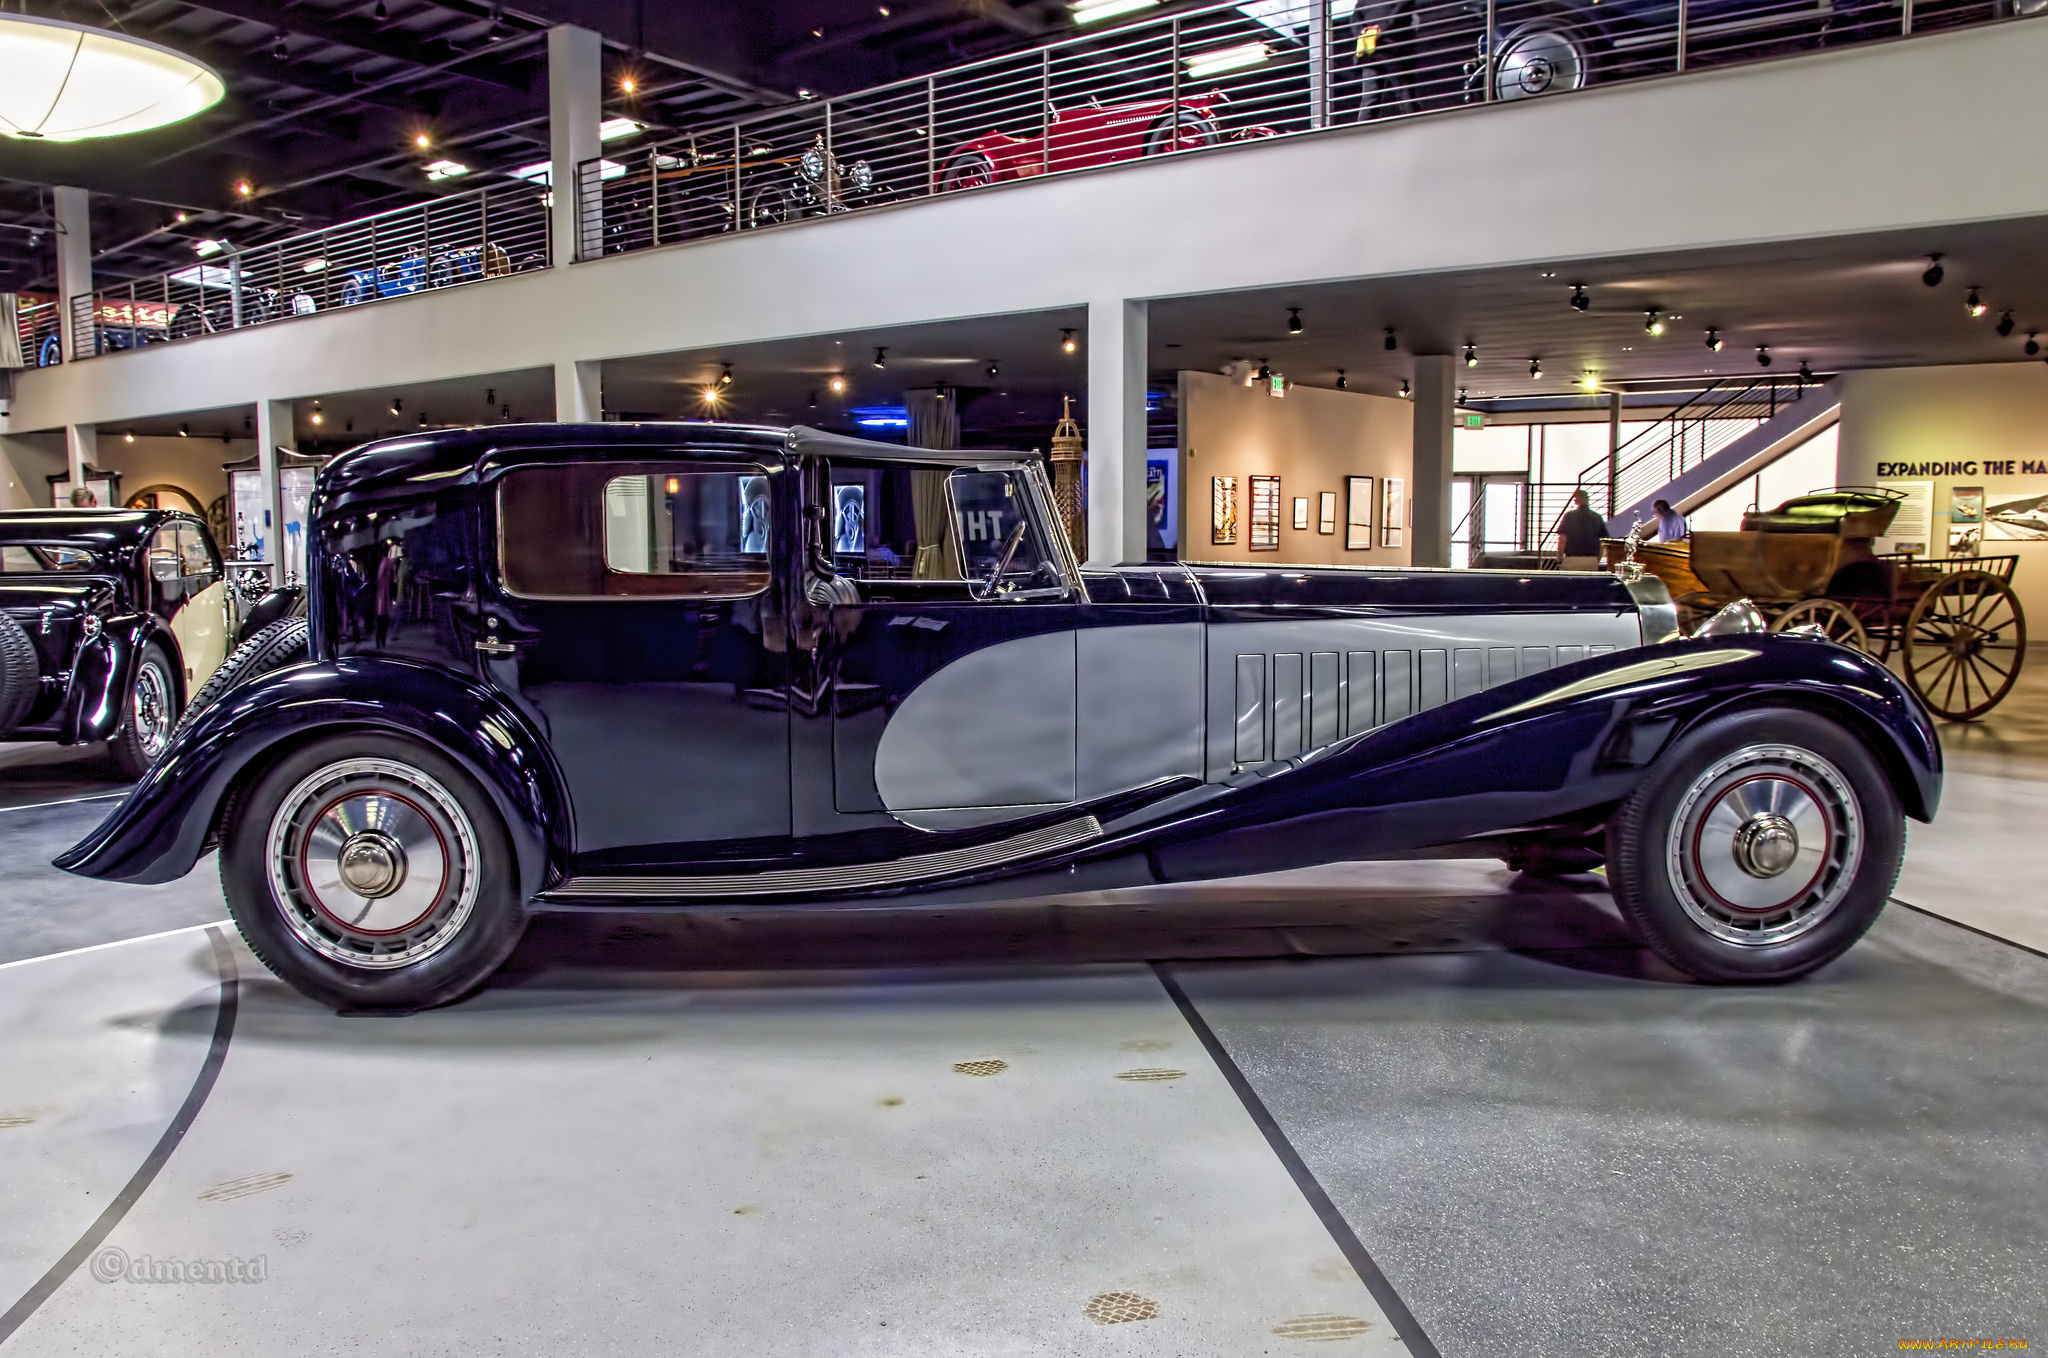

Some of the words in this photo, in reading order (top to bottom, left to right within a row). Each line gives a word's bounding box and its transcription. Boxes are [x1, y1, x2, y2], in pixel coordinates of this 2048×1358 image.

[1467, 415, 1482, 427] EXIT
[1877, 461, 1978, 477] EXPANDING
[1984, 460, 2016, 475] THE
